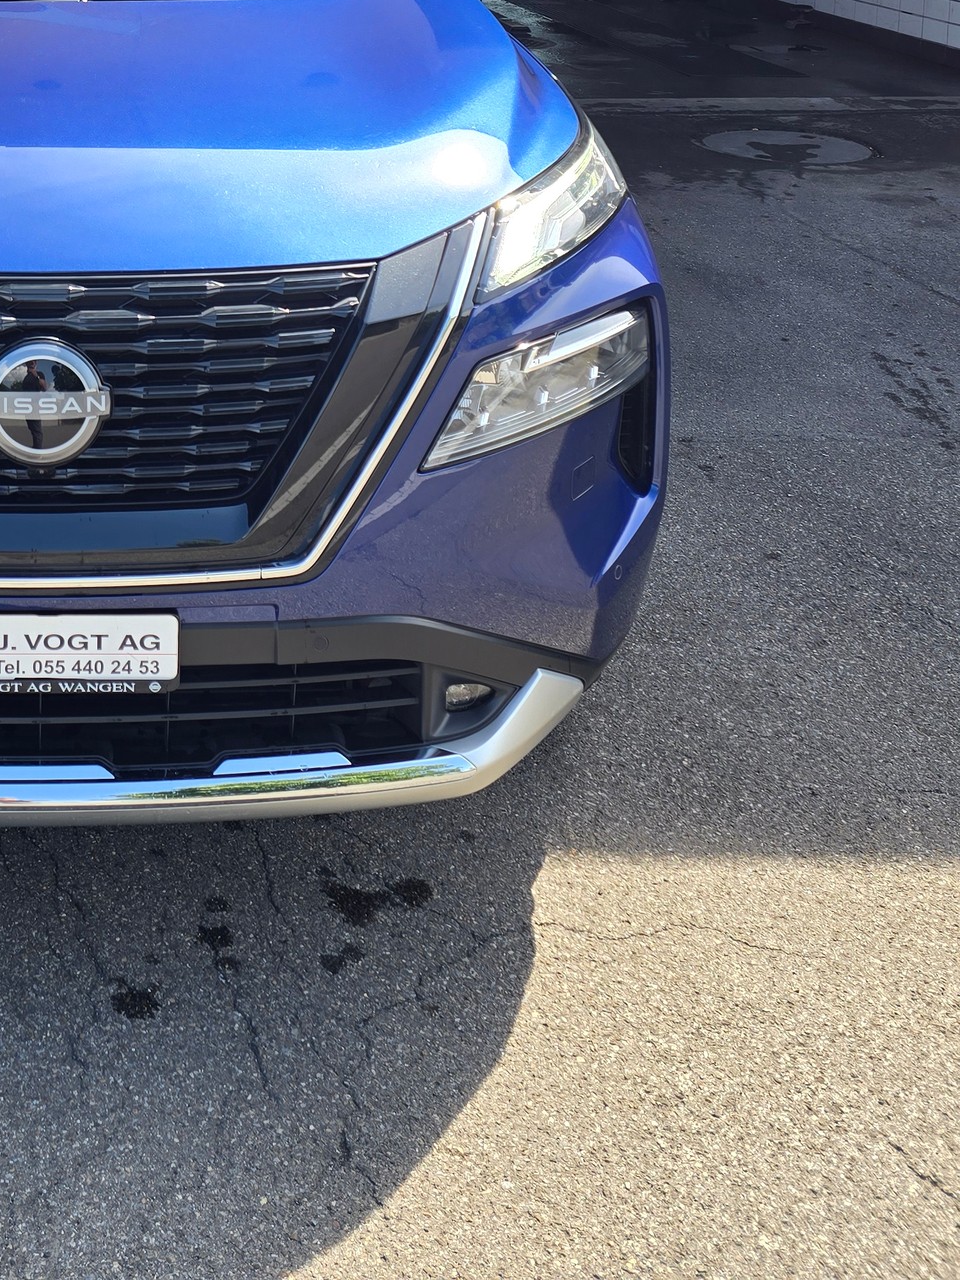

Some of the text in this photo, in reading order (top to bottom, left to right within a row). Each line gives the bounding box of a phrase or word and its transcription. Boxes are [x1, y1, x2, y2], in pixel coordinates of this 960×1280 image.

[24, 634, 109, 651] VOGT
[118, 634, 161, 651] AG
[32, 659, 65, 675] 055
[71, 659, 104, 675] 440
[110, 659, 133, 675] 24
[138, 659, 160, 675] 53
[26, 681, 53, 693] AG
[58, 681, 136, 693] WANGEN
